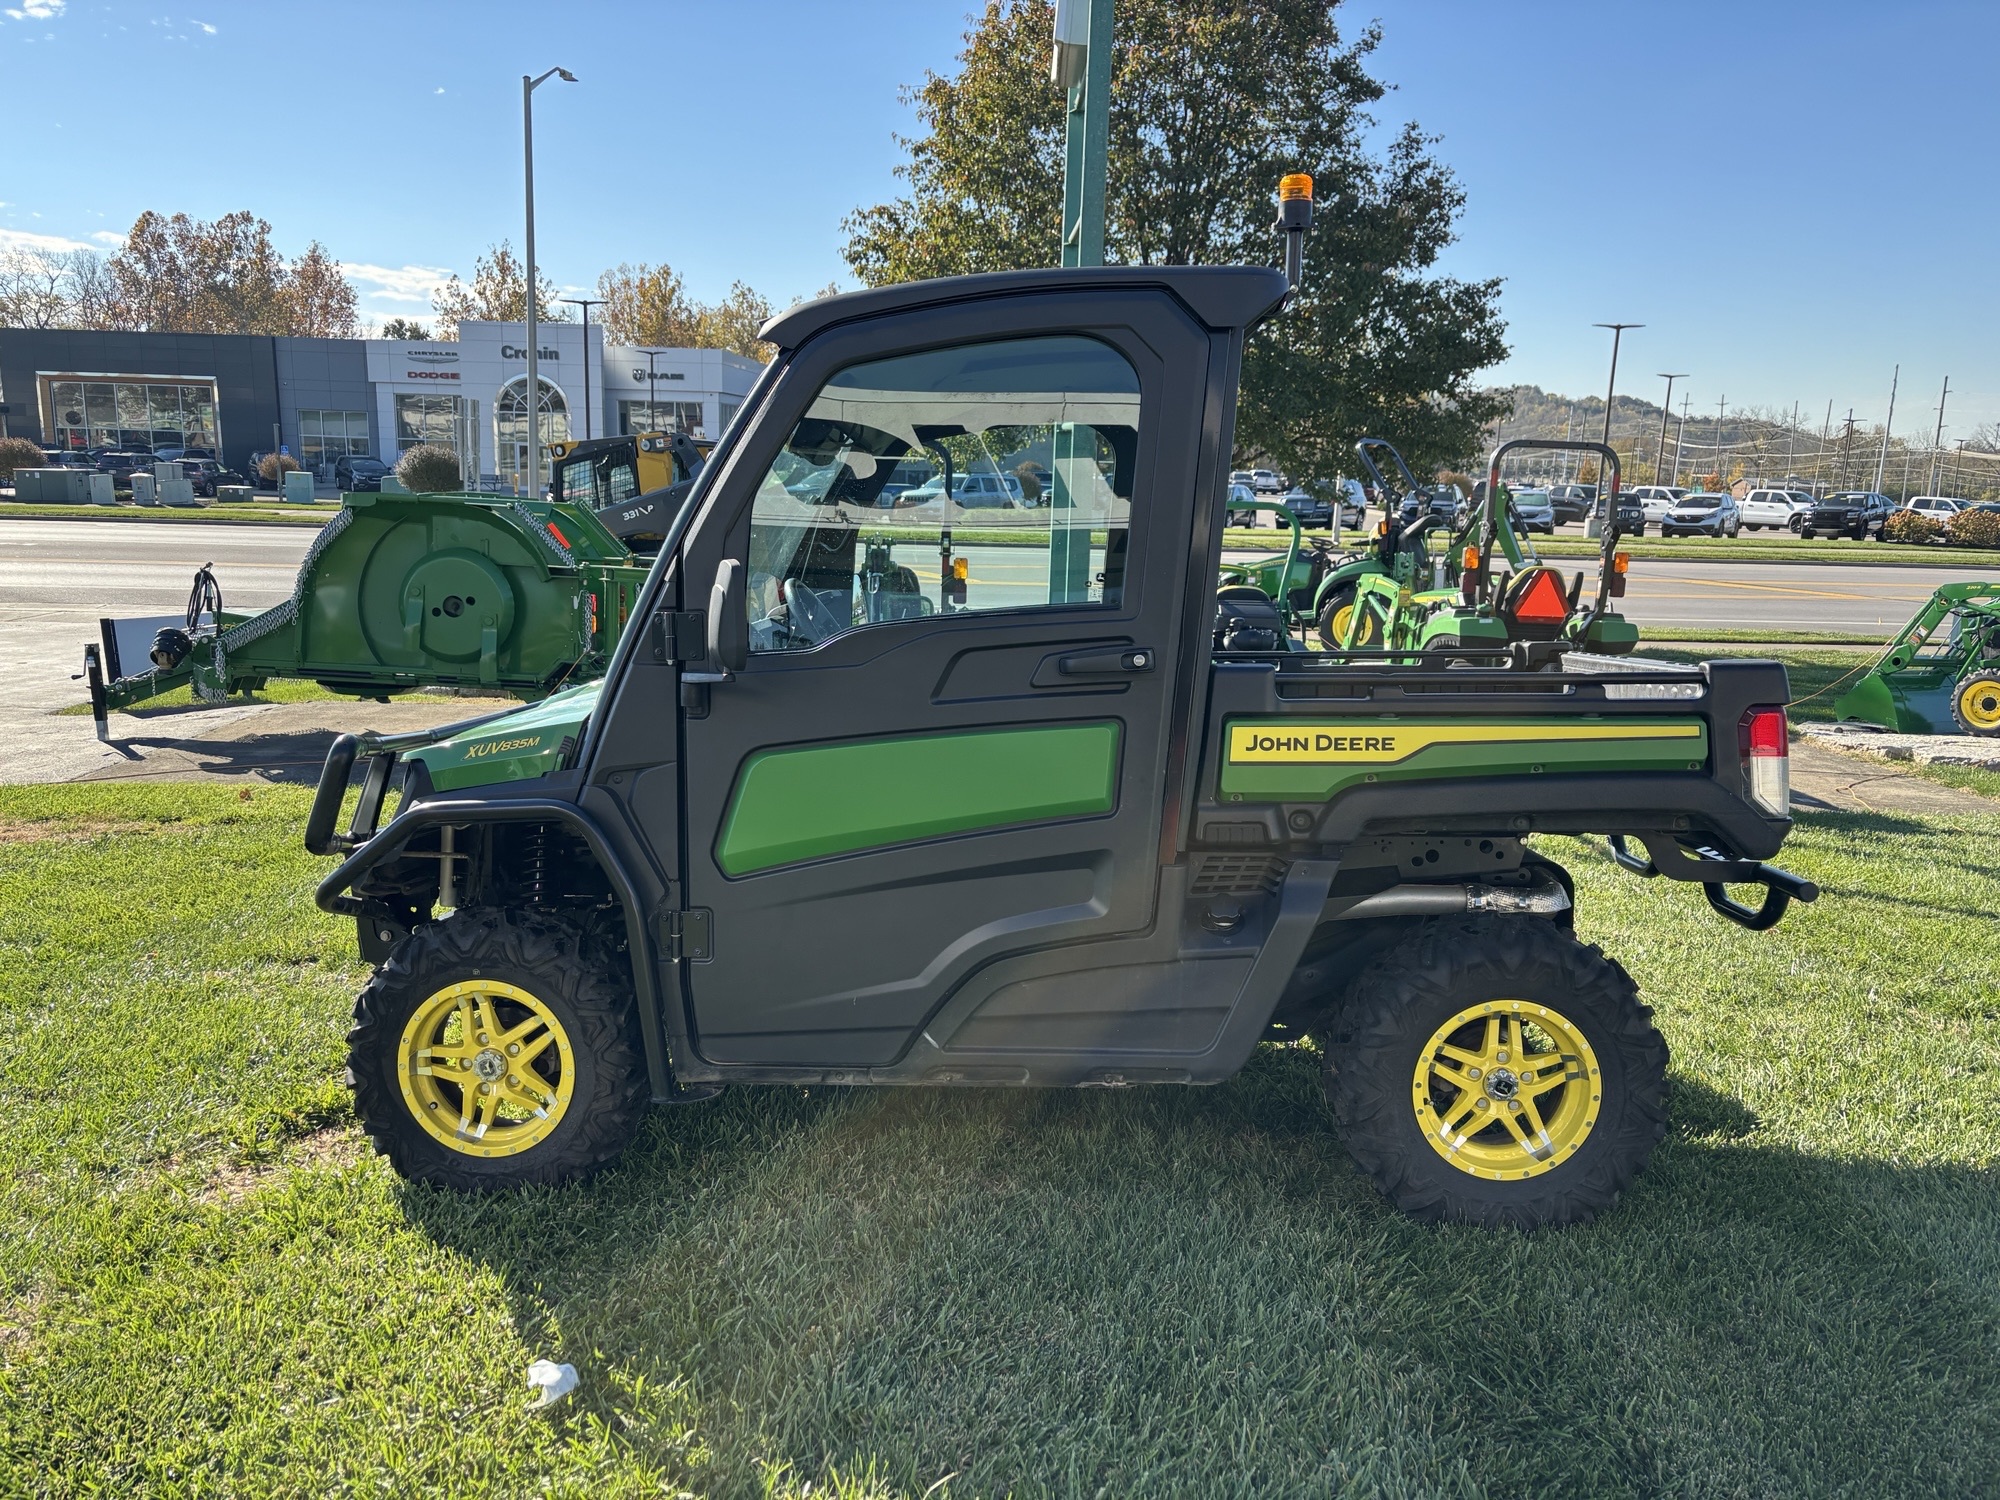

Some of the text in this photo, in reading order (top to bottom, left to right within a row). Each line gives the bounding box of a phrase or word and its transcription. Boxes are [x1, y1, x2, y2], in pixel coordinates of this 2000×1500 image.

[407, 371, 461, 380] DODGE
[462, 736, 541, 760] XUV835M
[1245, 734, 1396, 751] JOHN DEERE
